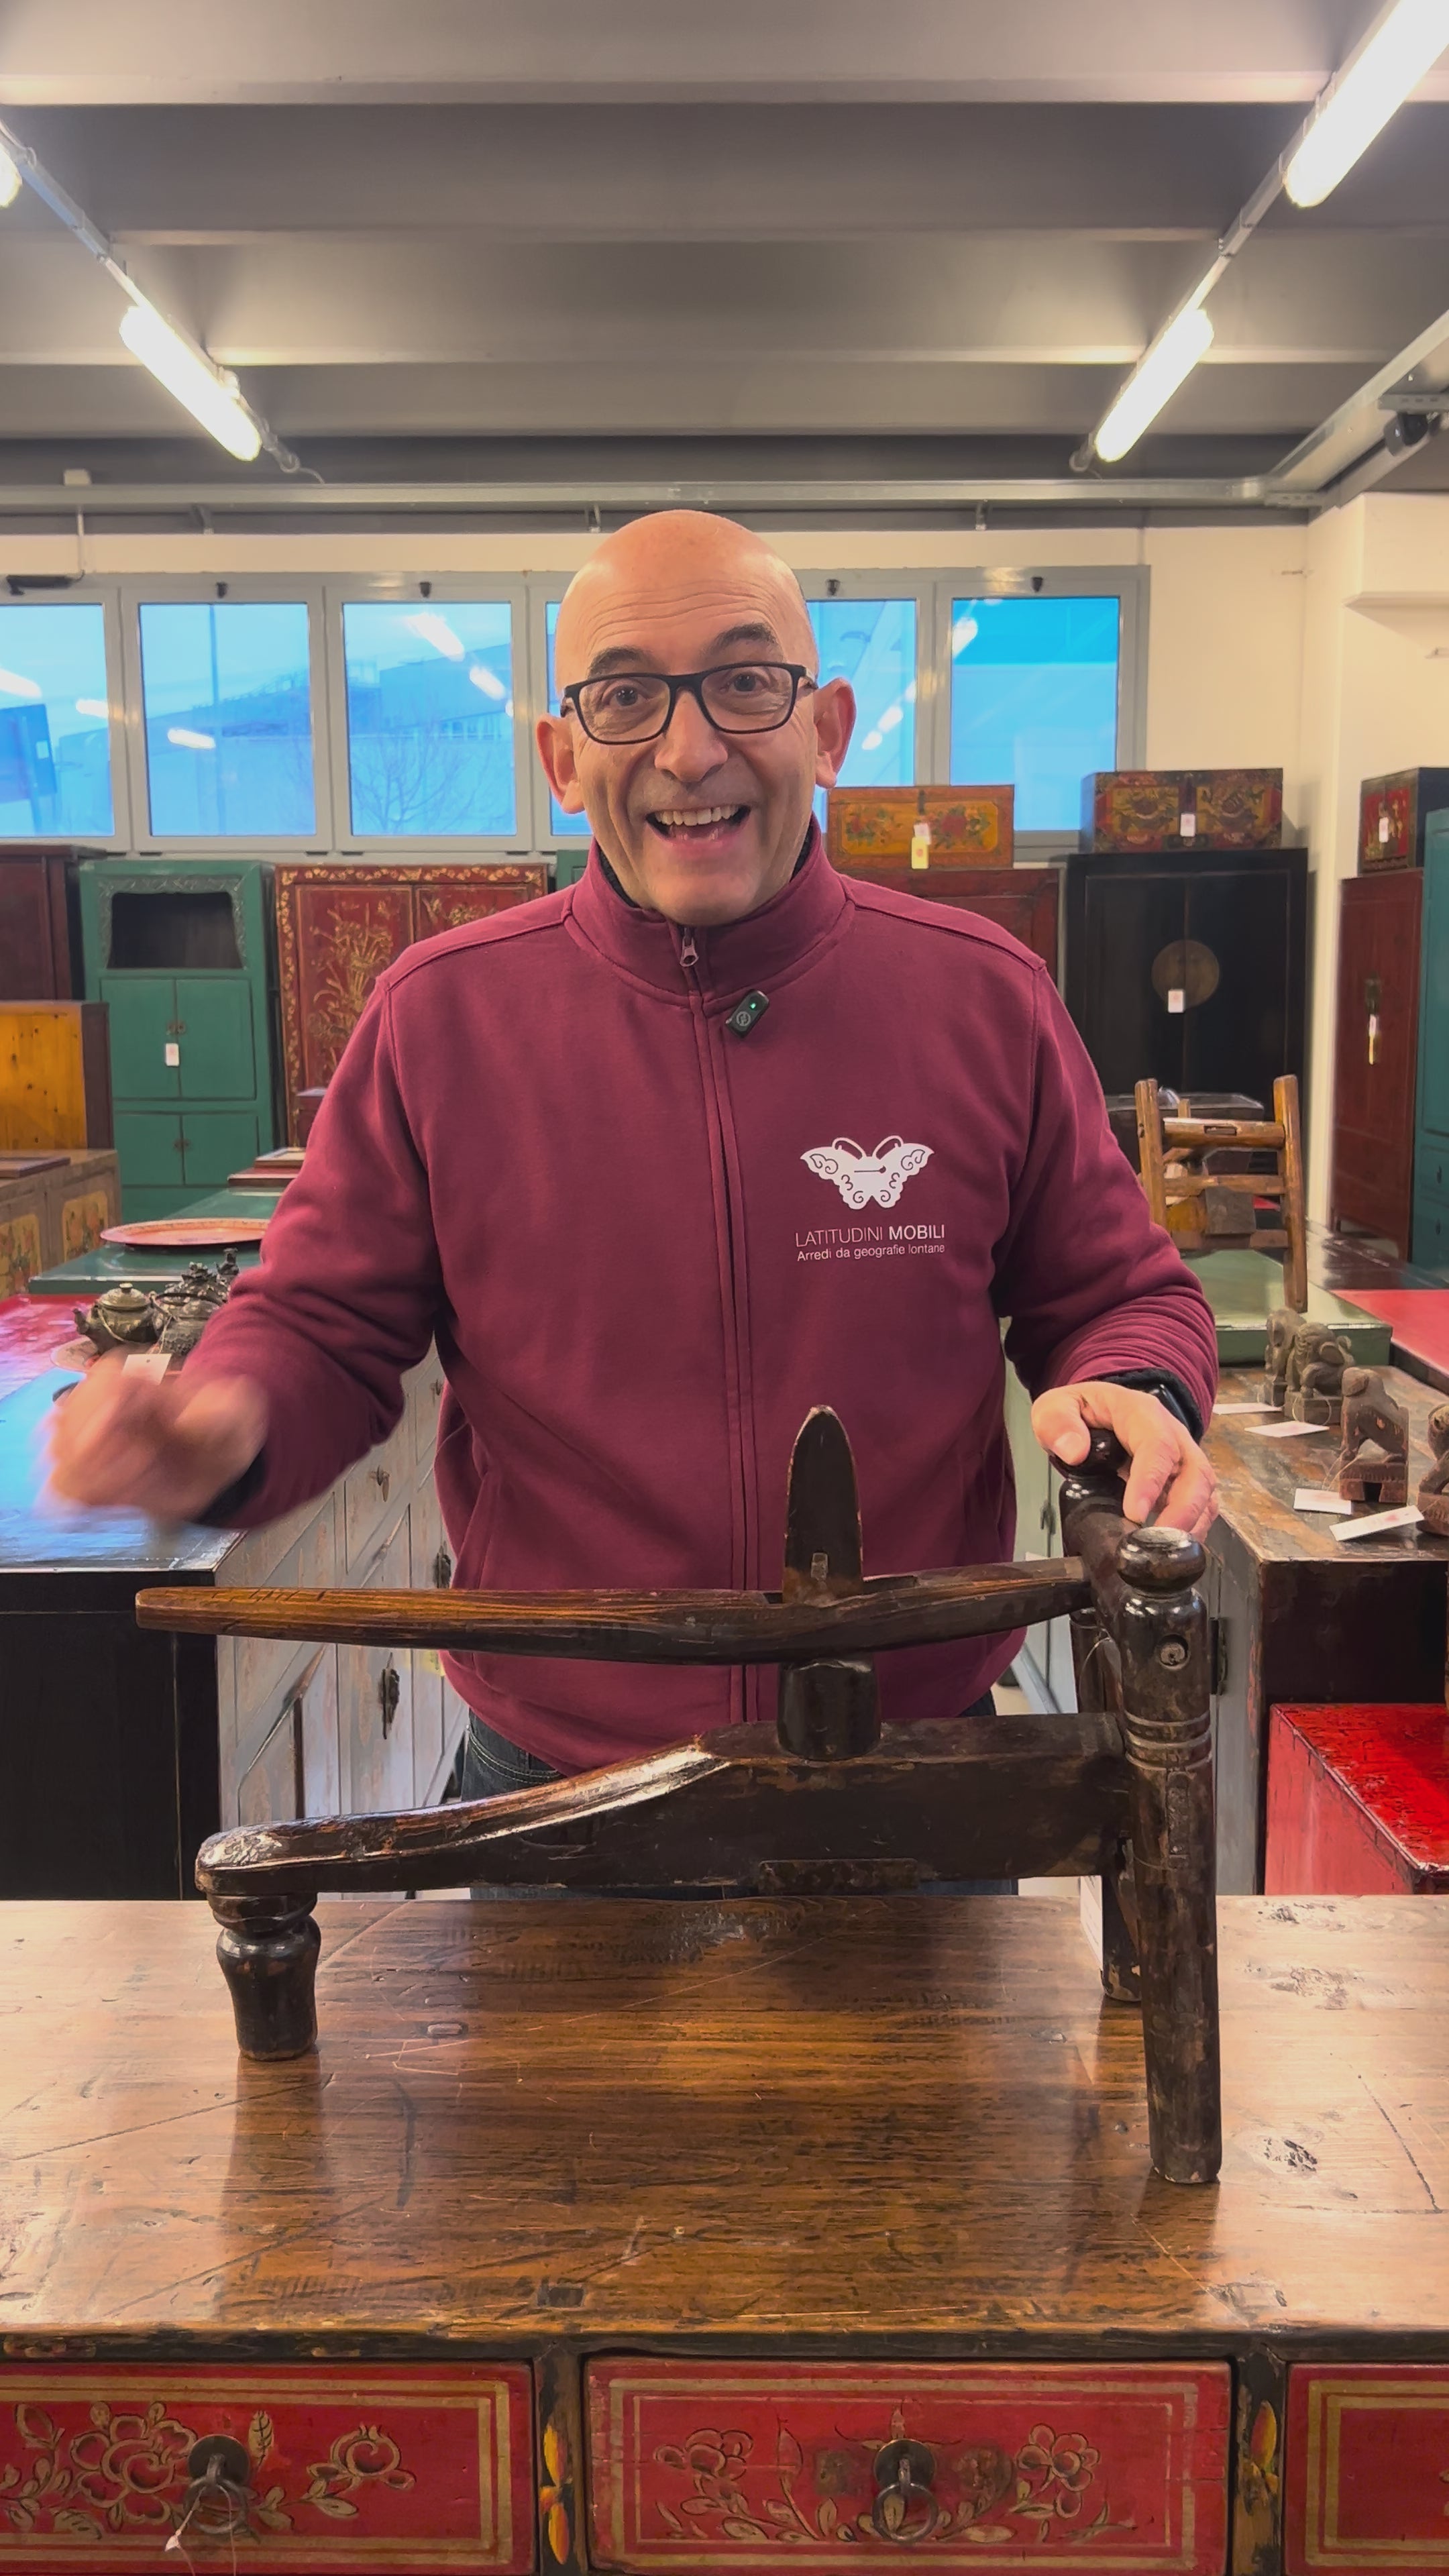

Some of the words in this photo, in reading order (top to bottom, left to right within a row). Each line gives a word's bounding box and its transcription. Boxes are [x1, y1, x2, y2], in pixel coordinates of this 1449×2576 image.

[796, 1226, 883, 1247] LATITUDINI
[889, 1224, 945, 1240] MOBILI
[797, 1248, 832, 1262] Arredi
[836, 1247, 851, 1258] da
[854, 1244, 905, 1260] geografie
[908, 1244, 945, 1254] lontane
